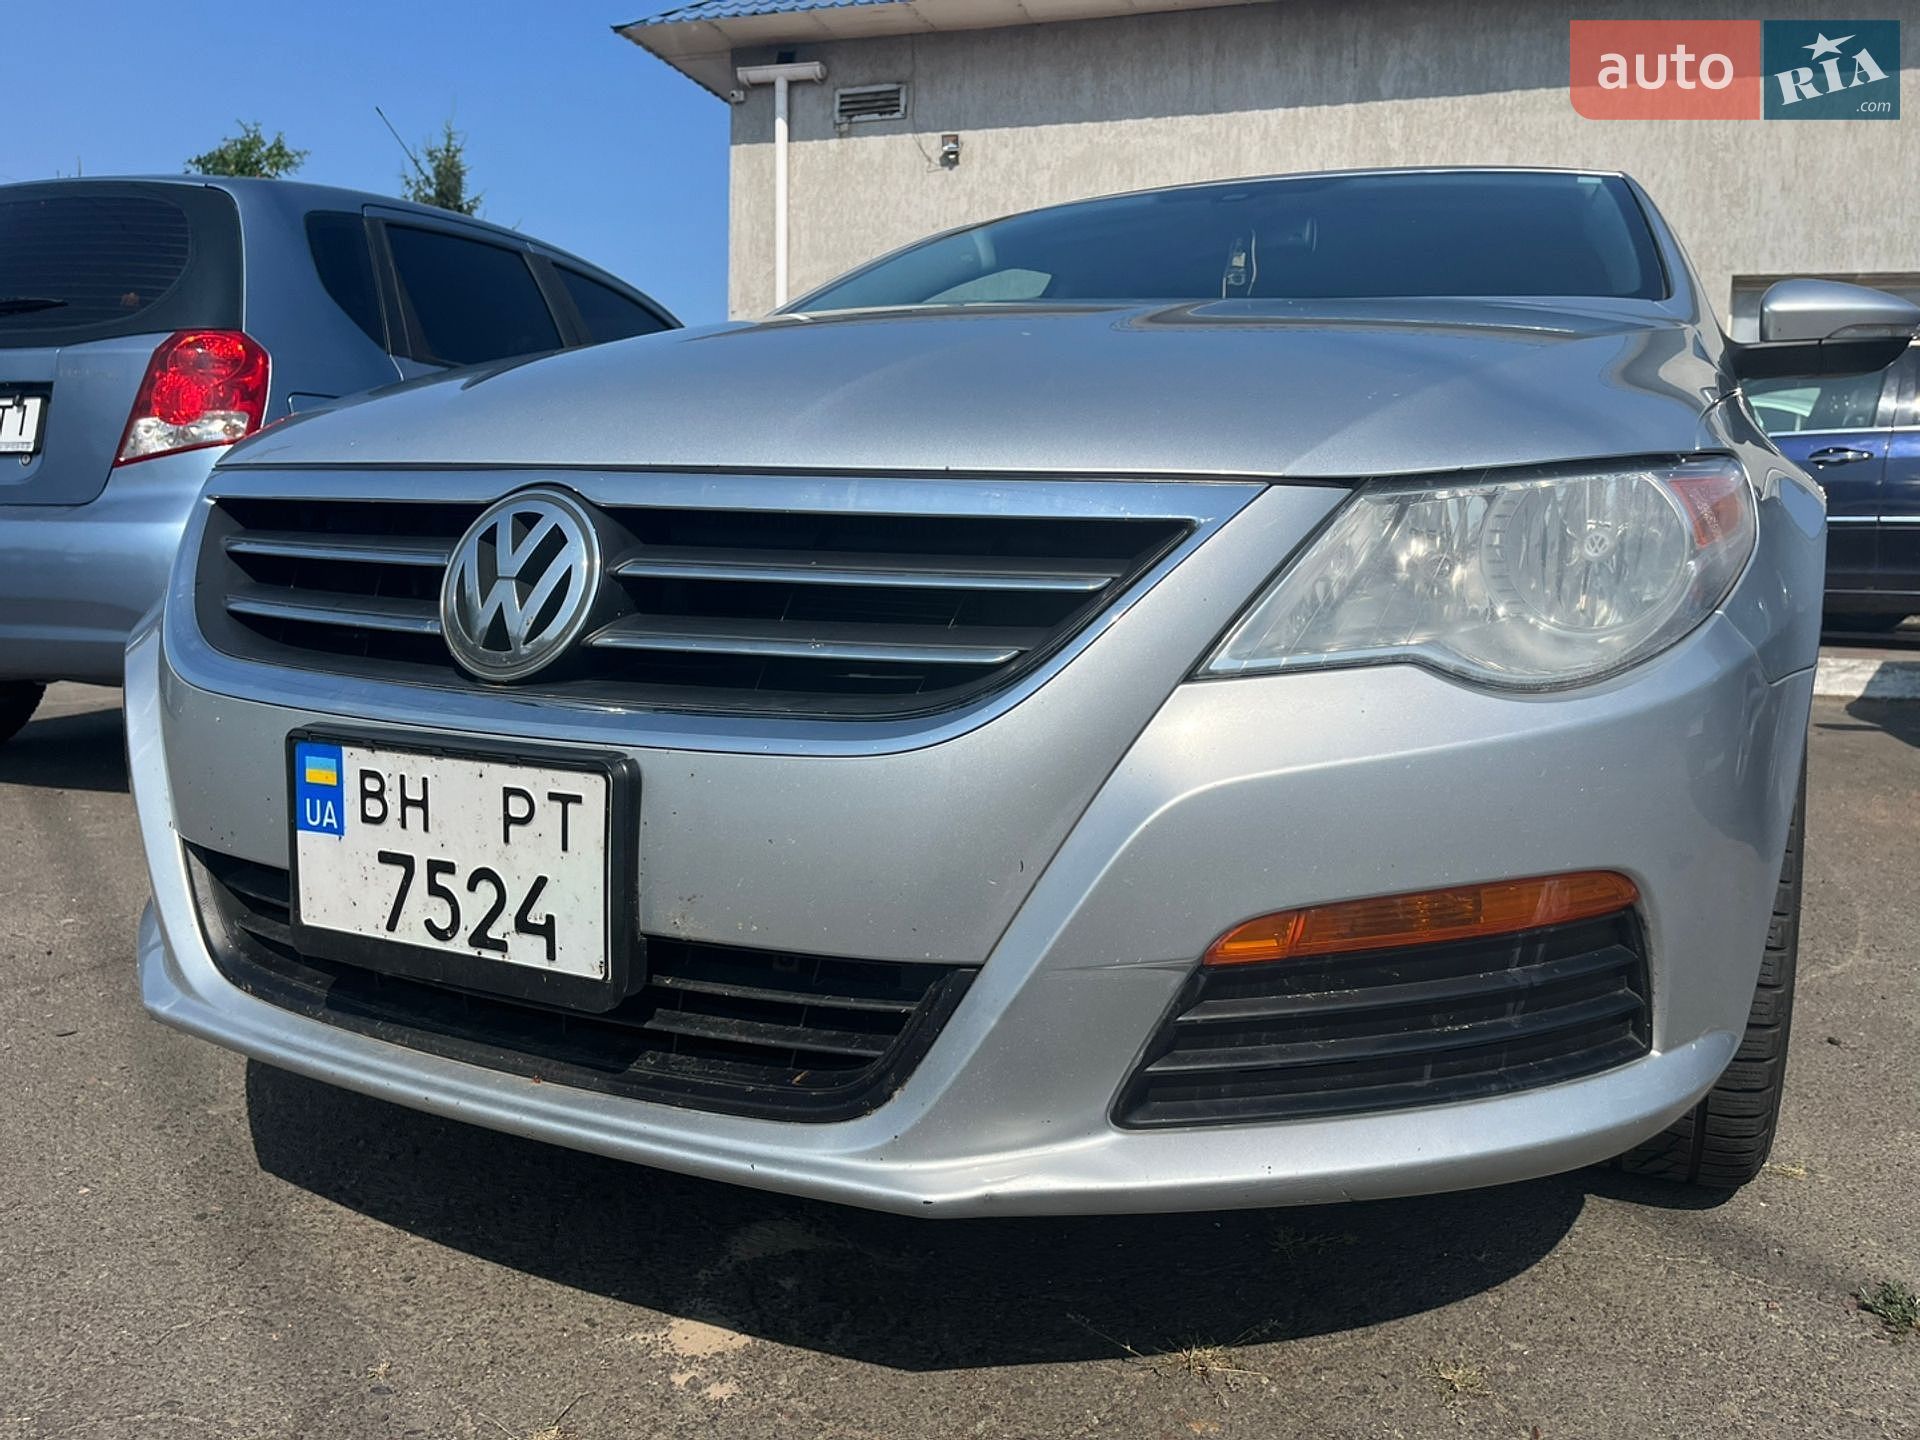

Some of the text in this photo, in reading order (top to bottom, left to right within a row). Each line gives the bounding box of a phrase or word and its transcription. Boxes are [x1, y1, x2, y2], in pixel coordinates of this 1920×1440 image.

[452, 498, 588, 668] VW
[305, 797, 338, 829] UA
[358, 768, 583, 852] BH PT
[377, 849, 556, 961] 7524
